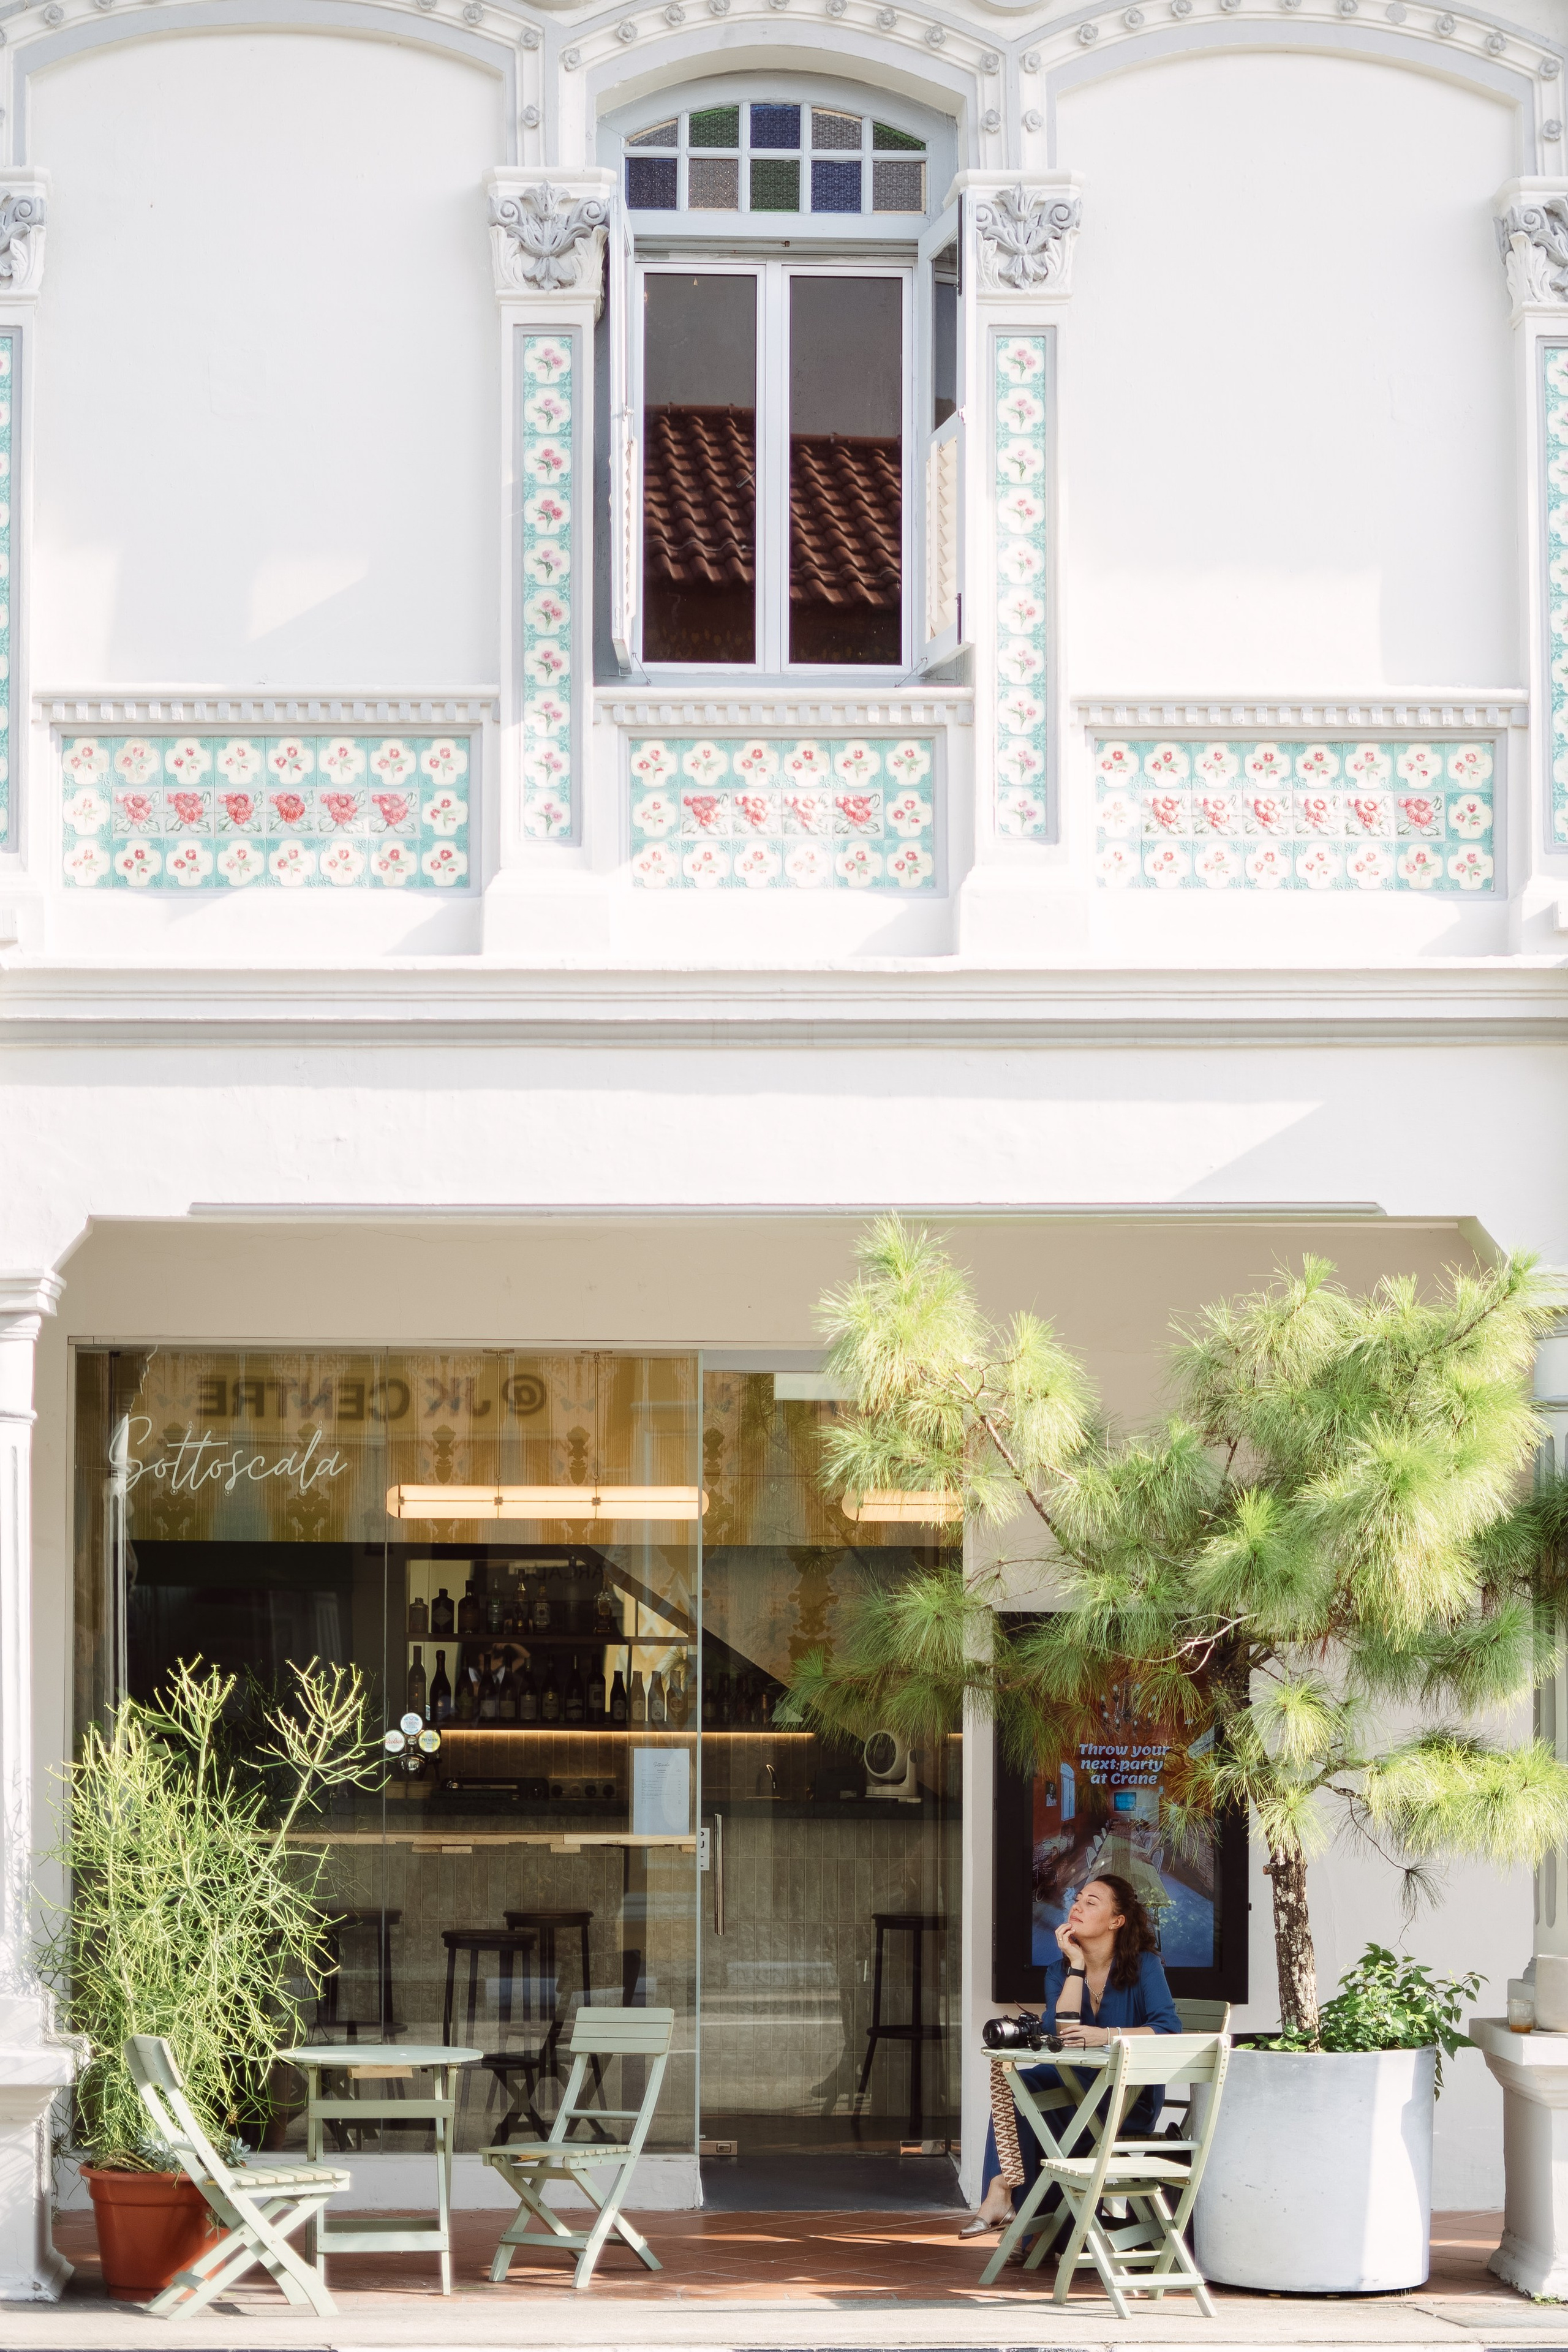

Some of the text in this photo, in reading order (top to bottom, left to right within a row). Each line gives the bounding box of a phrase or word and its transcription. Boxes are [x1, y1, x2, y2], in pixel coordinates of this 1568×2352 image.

[108, 1415, 348, 1493] Sottoscala
[1079, 1743, 1171, 1758] Throw your
[1080, 1758, 1163, 1772] next party
[1090, 1773, 1158, 1784] at Crane
